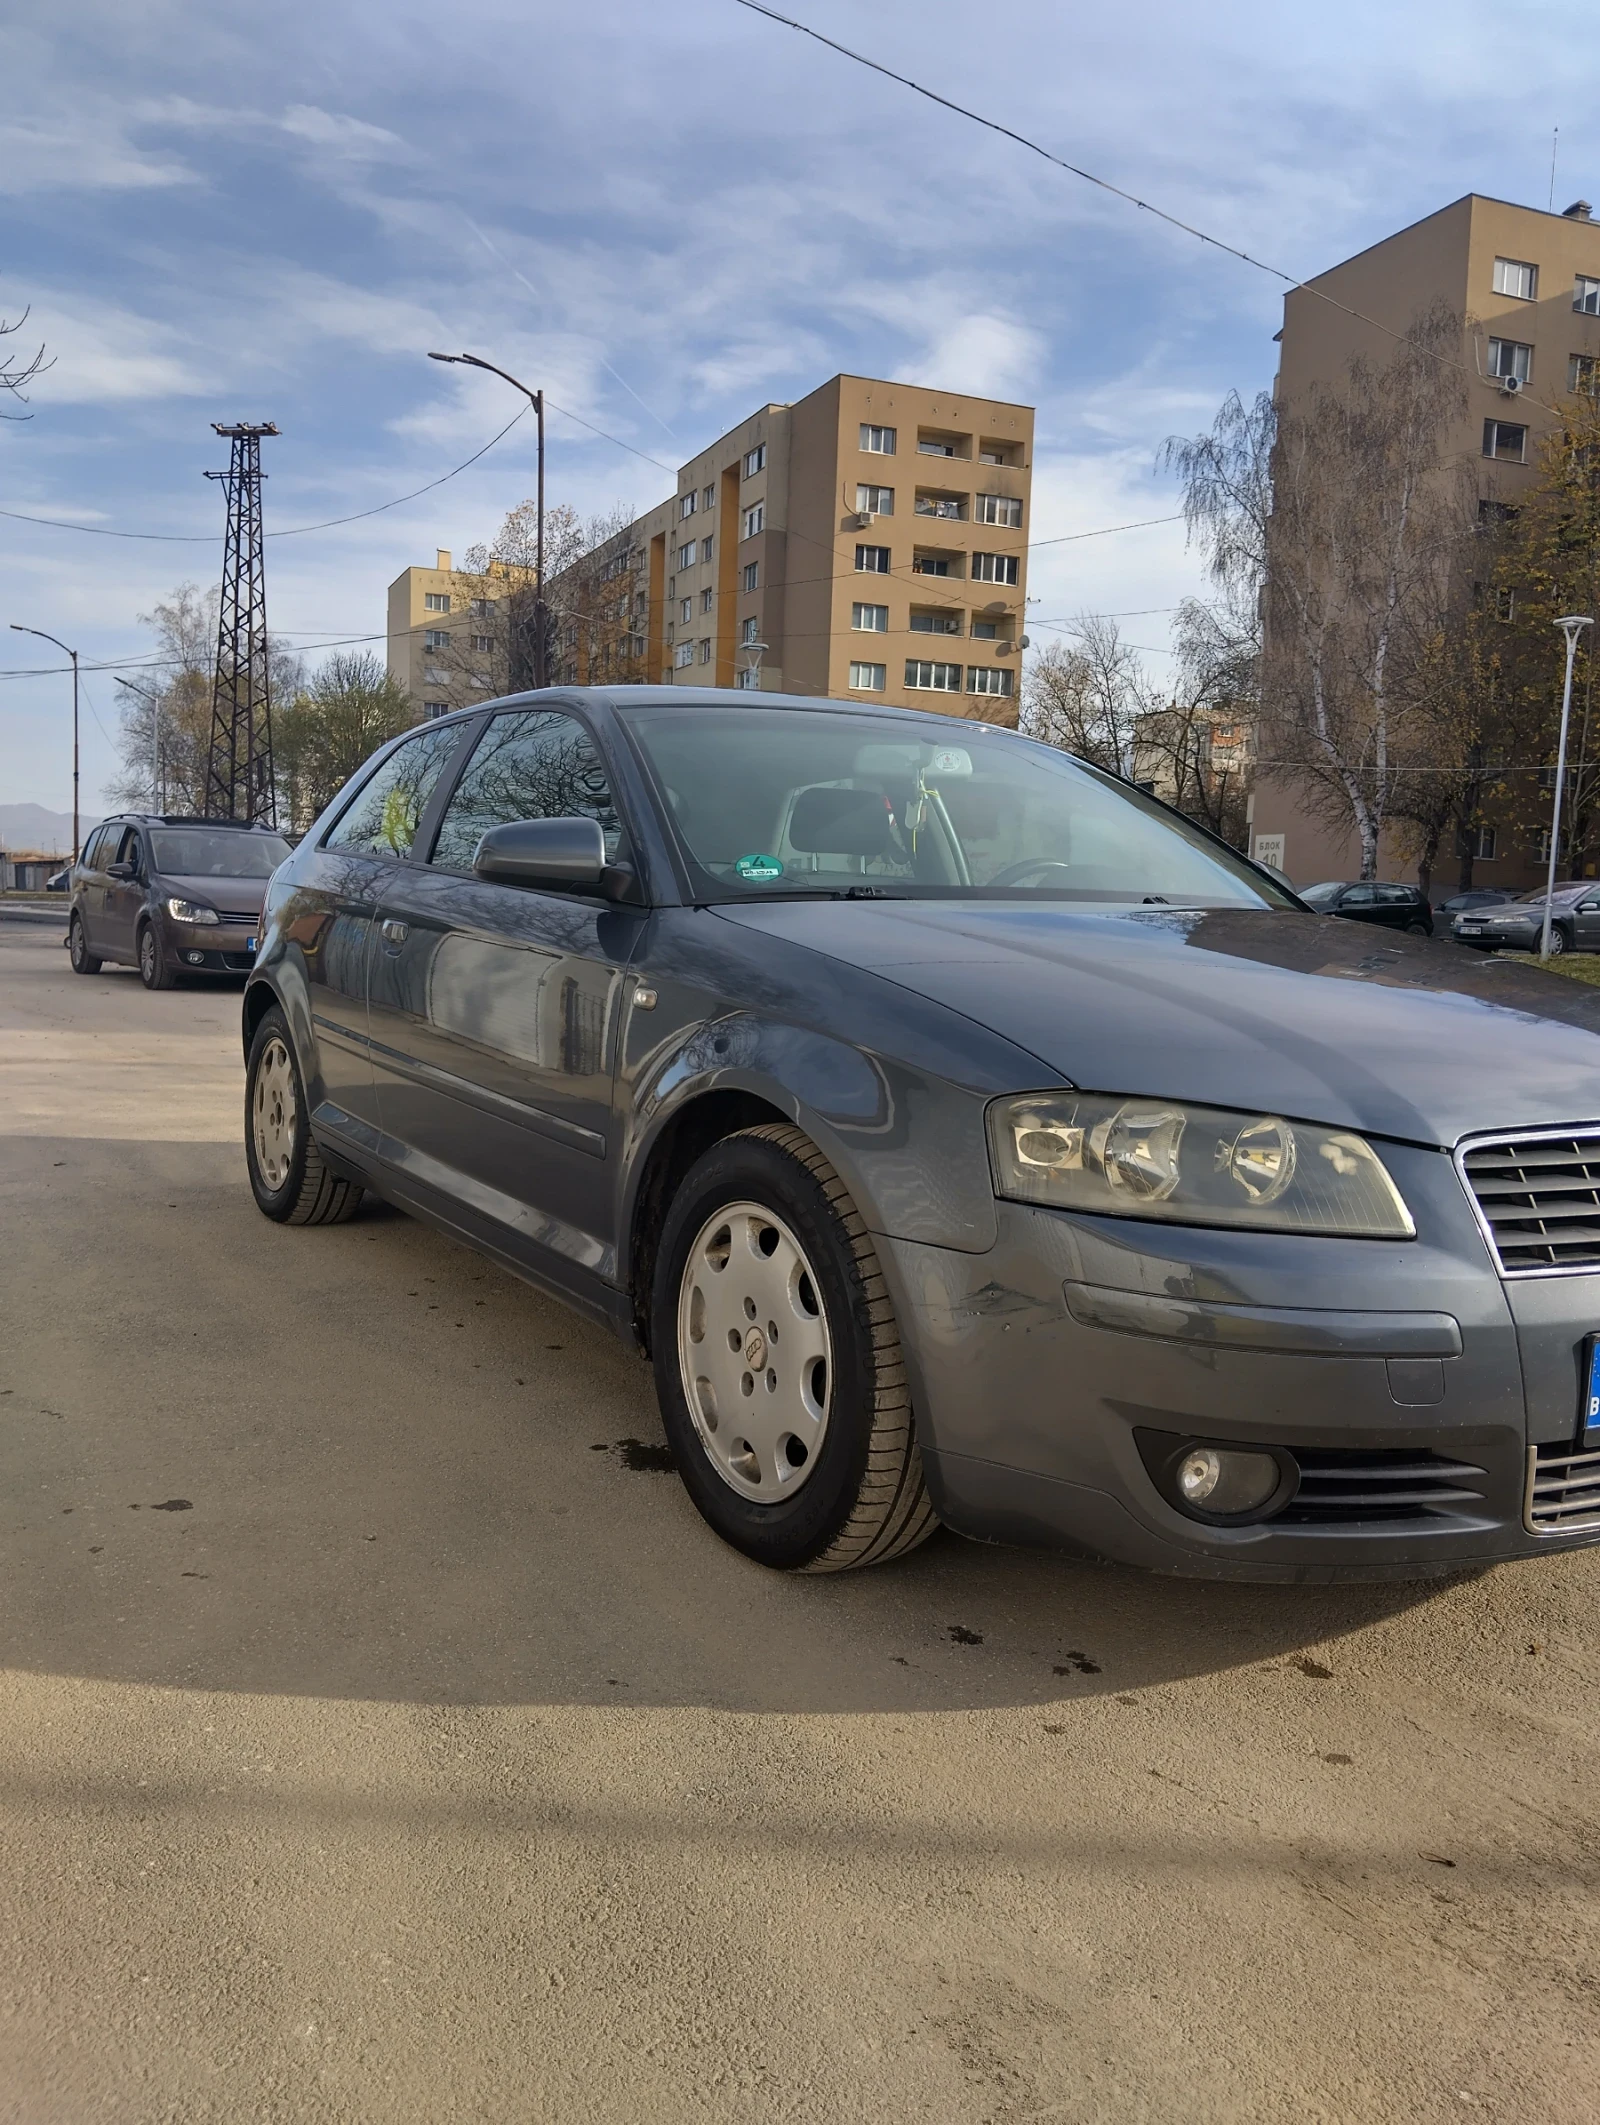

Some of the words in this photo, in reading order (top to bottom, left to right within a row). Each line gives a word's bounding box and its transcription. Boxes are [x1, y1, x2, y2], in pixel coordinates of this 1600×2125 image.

[1259, 841, 1281, 851] БЛОК
[752, 856, 766, 868] 4
[1263, 853, 1277, 867] 10
